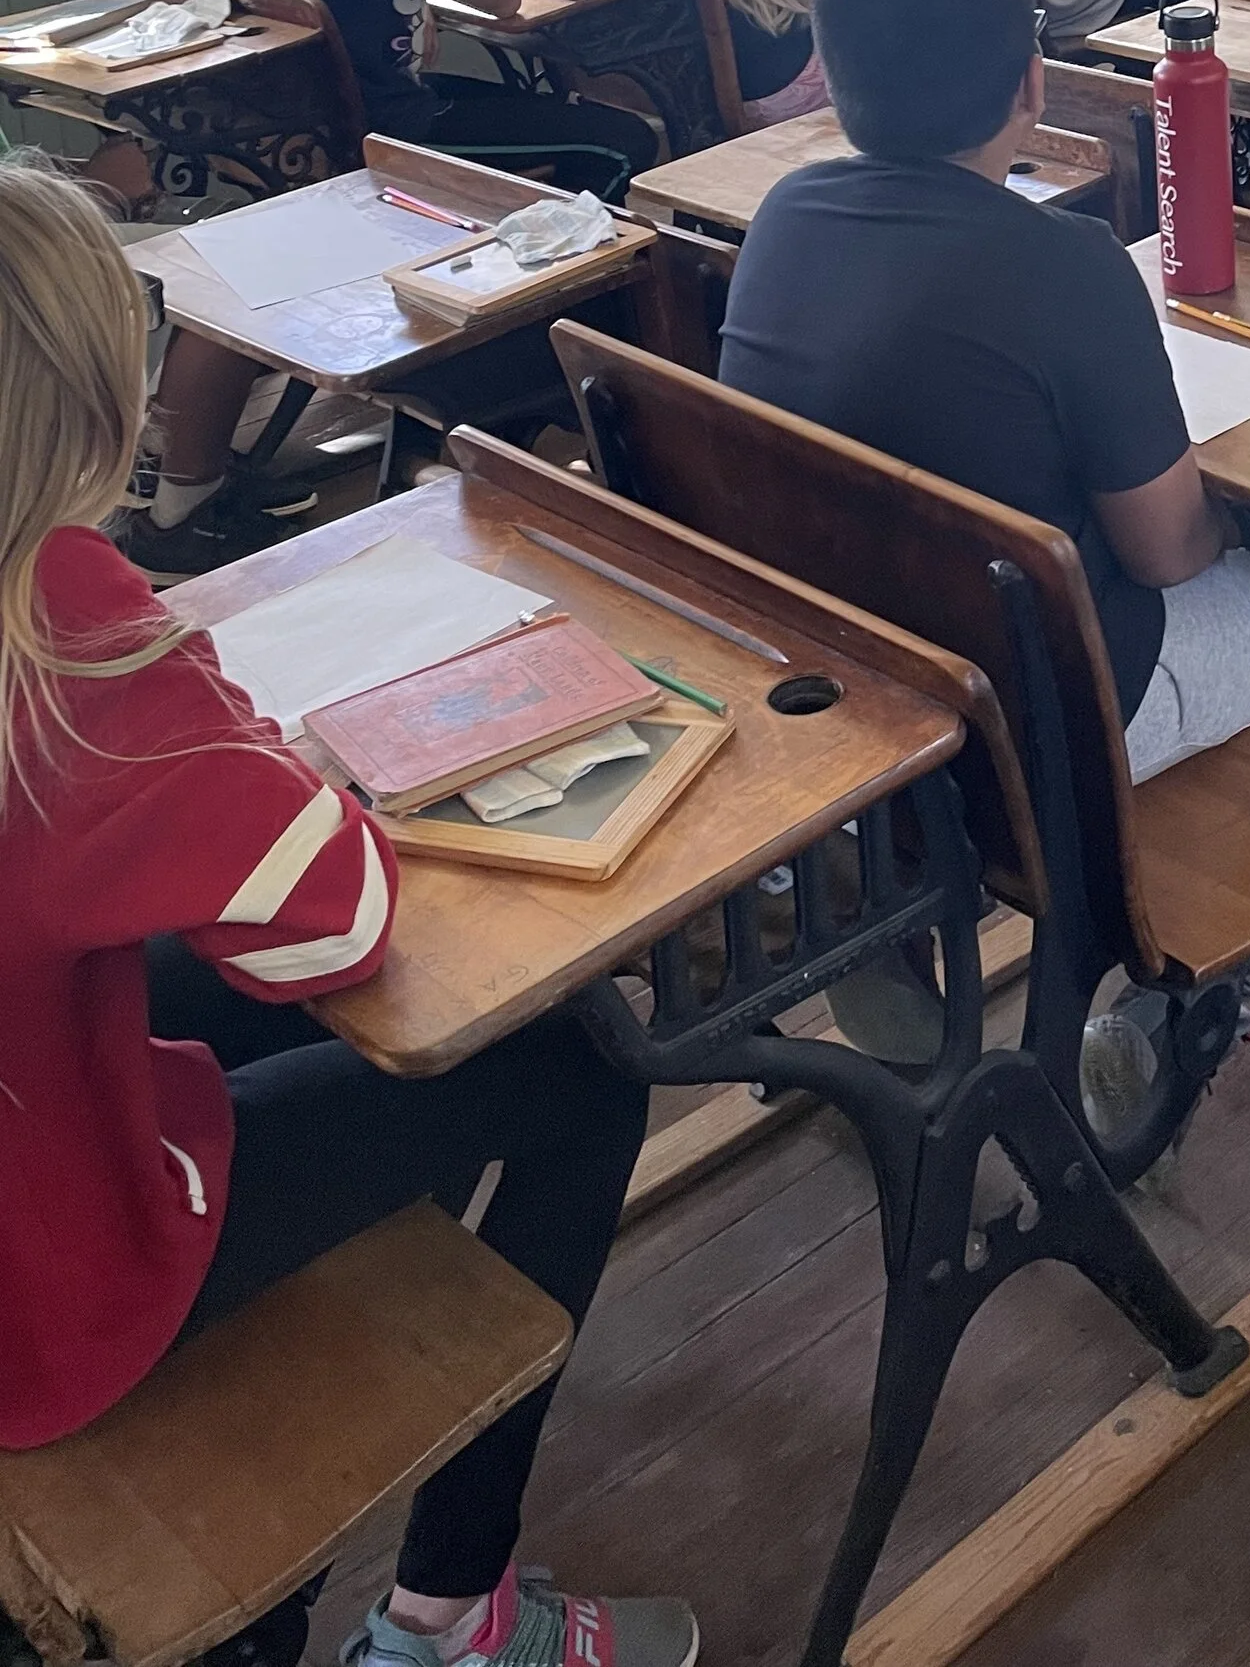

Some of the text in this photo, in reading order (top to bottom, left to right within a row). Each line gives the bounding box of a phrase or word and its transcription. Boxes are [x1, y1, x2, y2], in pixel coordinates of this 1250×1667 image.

[1154, 95, 1184, 276] Talent Search
[574, 1597, 602, 1667] FIL
